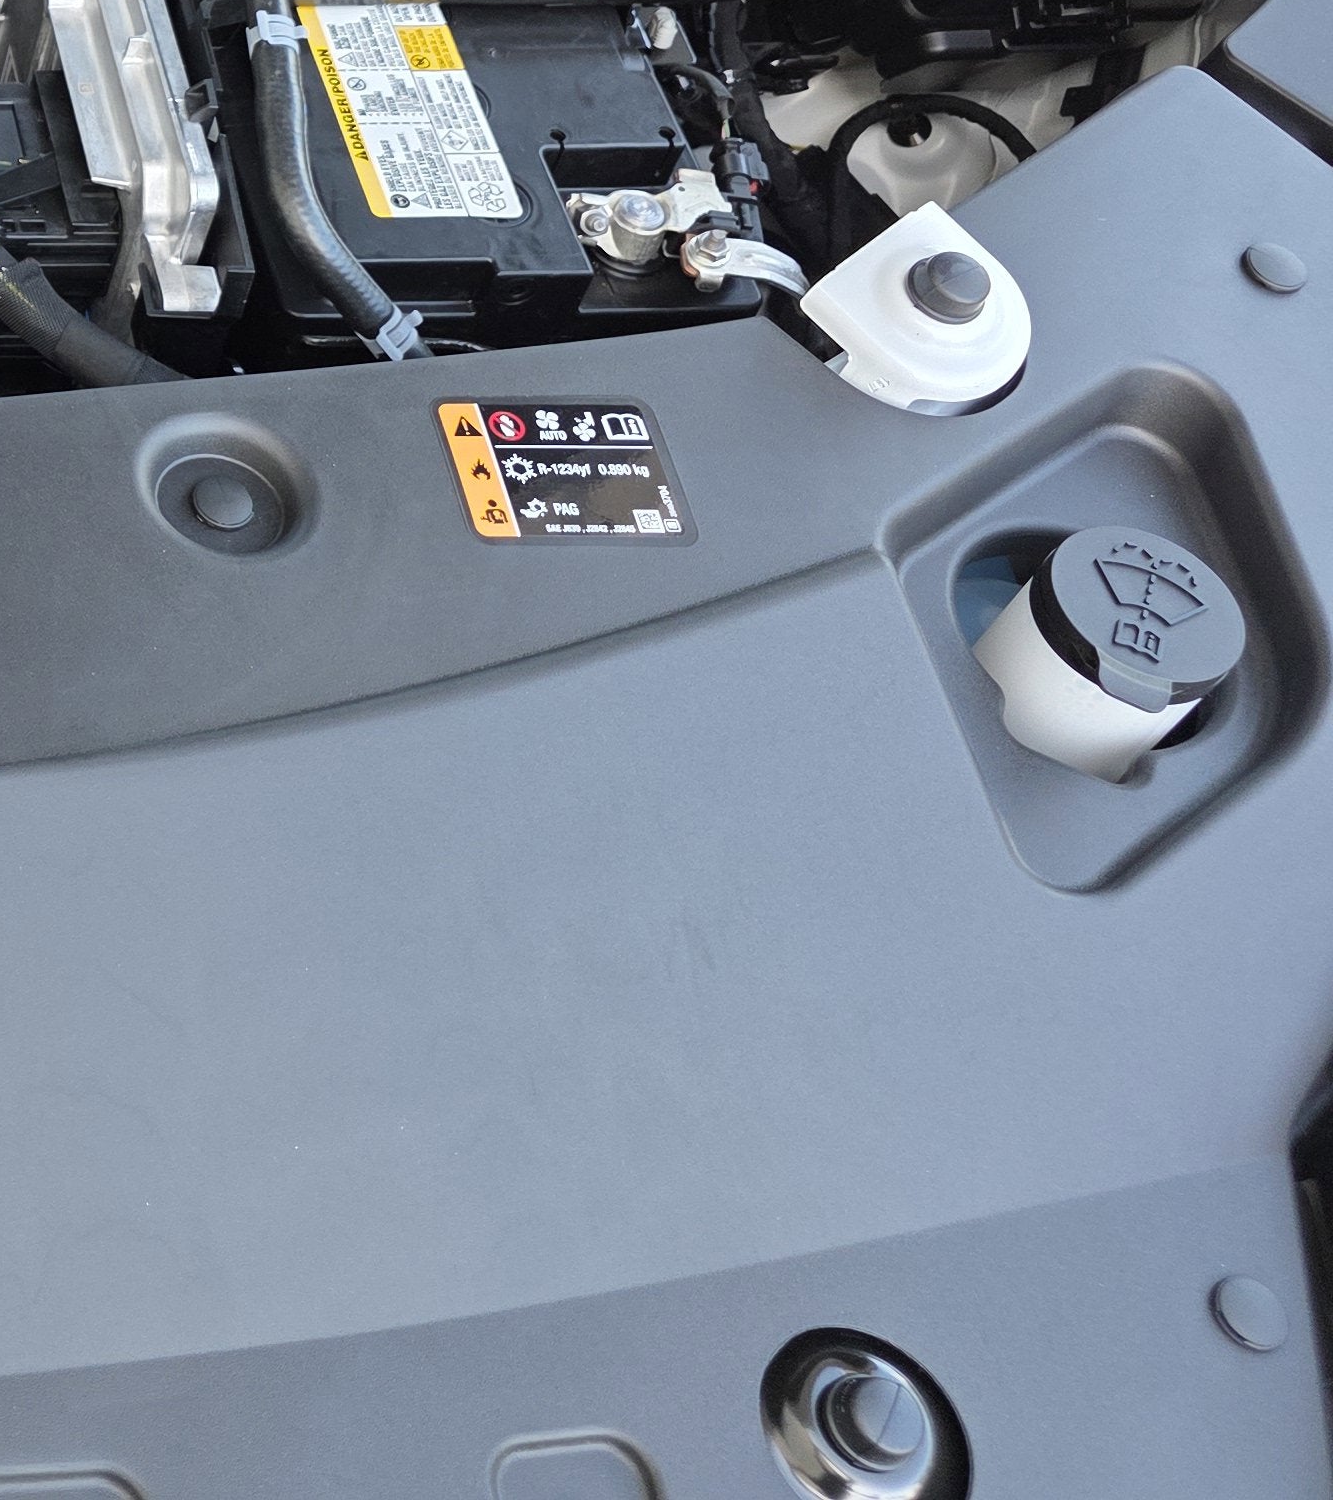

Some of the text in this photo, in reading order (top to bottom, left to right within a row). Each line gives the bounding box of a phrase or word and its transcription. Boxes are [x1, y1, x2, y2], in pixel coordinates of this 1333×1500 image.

[315, 48, 365, 148] DANGER/POISON
[539, 430, 568, 441] AUTO
[632, 463, 650, 478] kg
[552, 502, 580, 517] PAG
